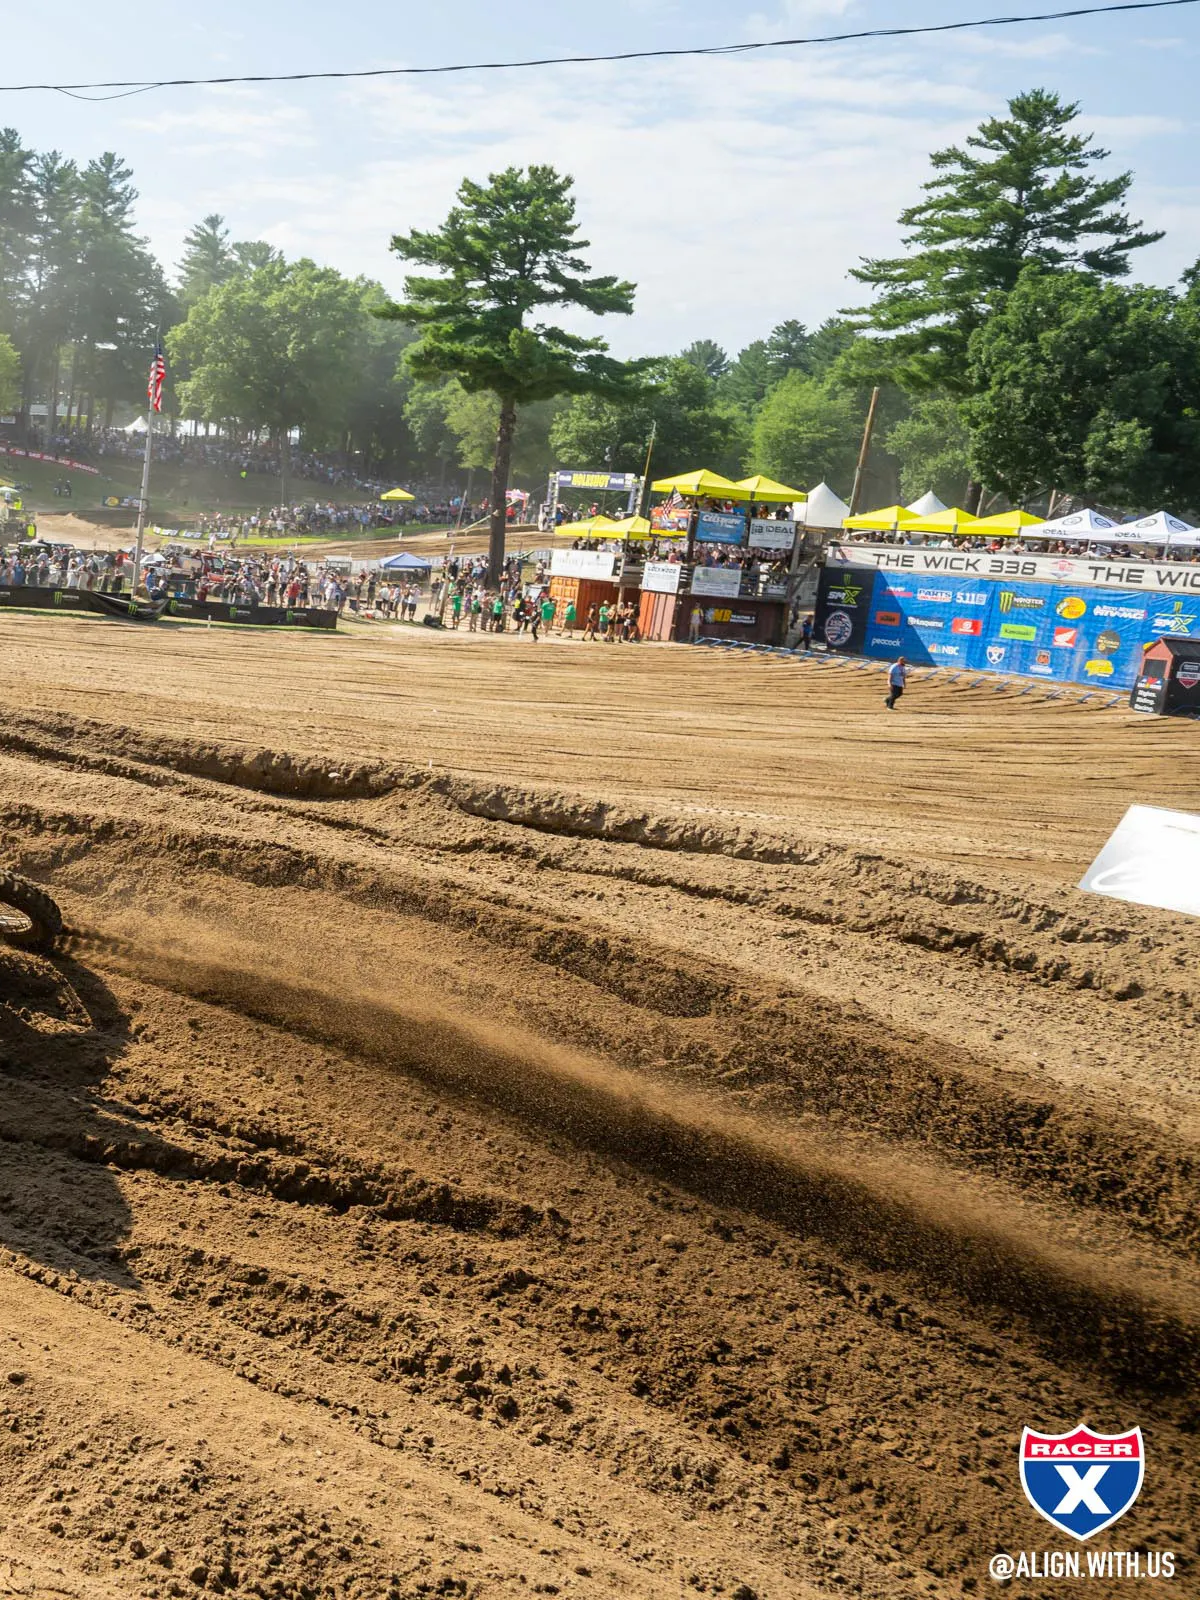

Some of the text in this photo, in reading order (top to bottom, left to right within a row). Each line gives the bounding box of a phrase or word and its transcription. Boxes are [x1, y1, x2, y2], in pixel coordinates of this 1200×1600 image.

[765, 525, 794, 535] IDEAL
[1043, 528, 1068, 536] IDEAL
[873, 553, 1038, 576] THE WICK 338
[1088, 566, 1145, 583] THE
[918, 589, 952, 598] PARTS
[871, 637, 901, 648] peacock
[942, 645, 960, 656] NBC
